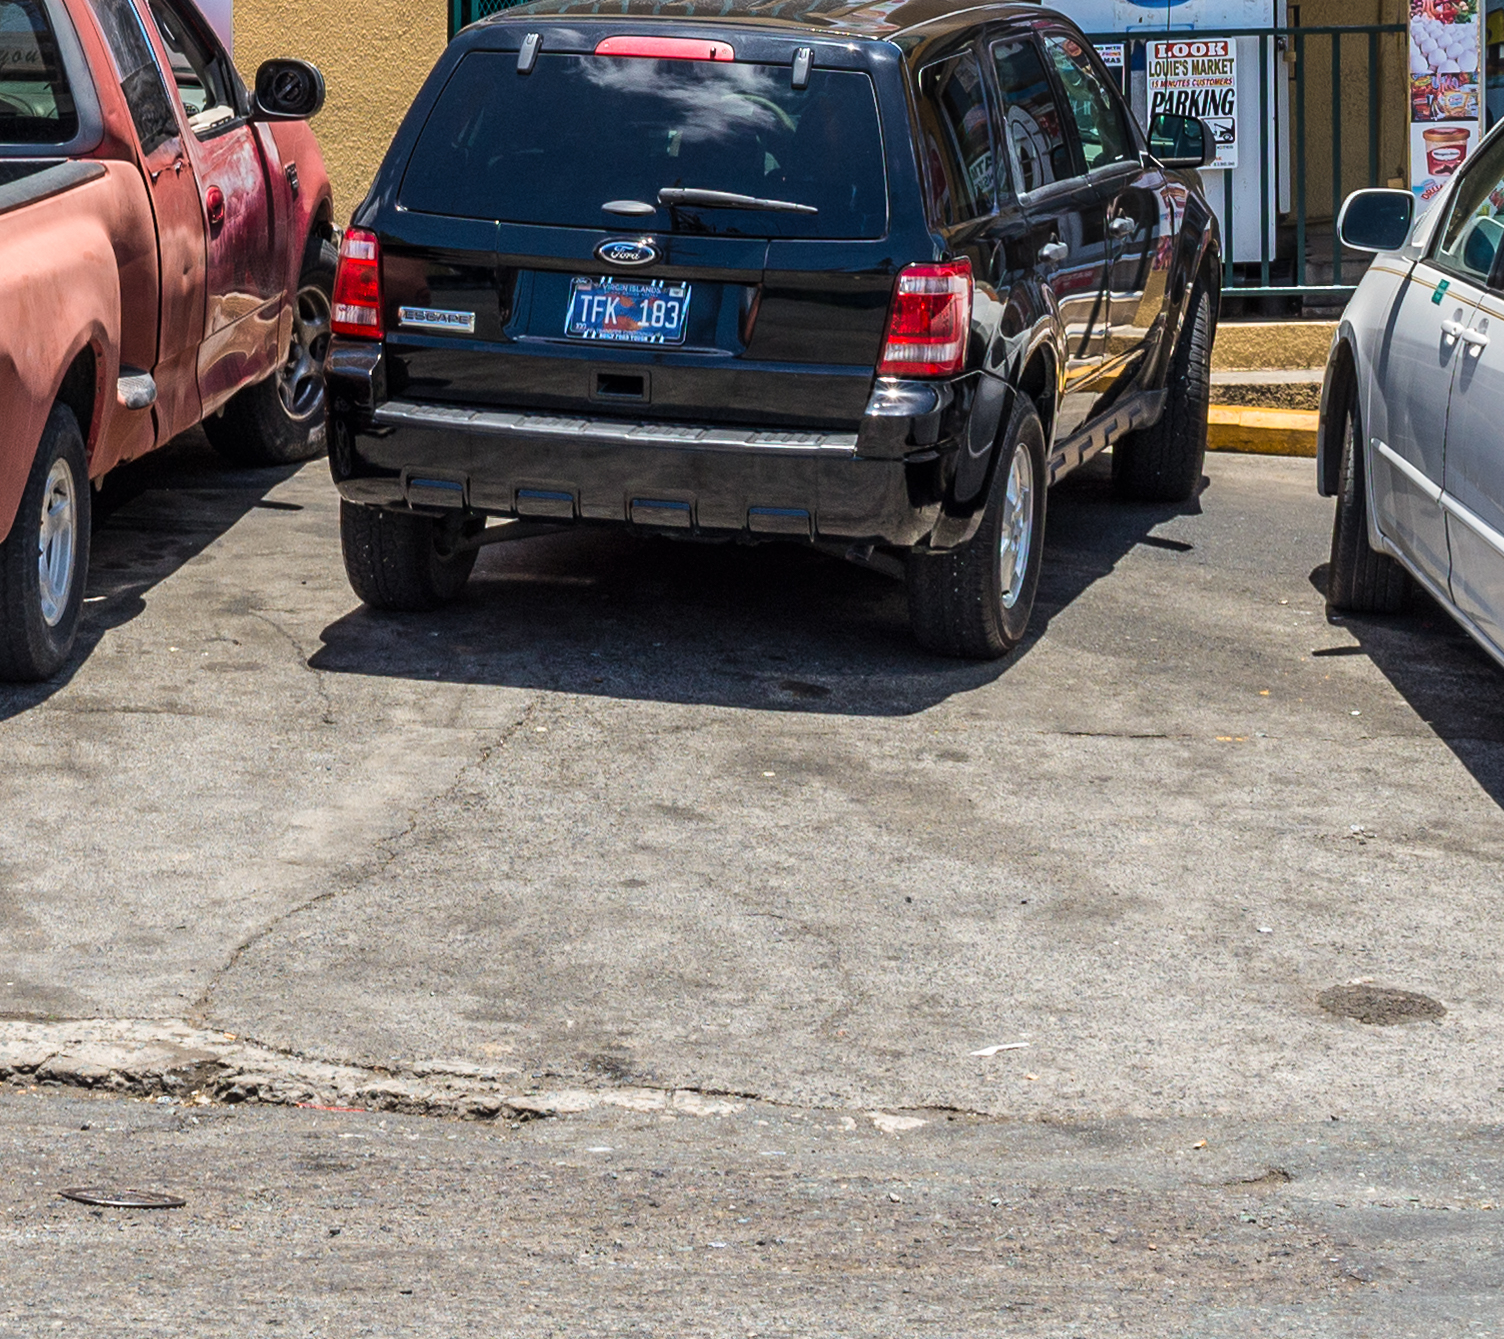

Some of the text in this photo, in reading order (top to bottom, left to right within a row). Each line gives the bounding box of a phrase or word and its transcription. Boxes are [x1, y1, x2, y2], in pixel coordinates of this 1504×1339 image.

[1157, 42, 1226, 57] LOOK
[1149, 58, 1234, 77] LOUIE'S MARKET
[1151, 88, 1235, 117] PARKING
[610, 243, 641, 260] Ford
[404, 310, 469, 325] ESCAPE
[580, 294, 679, 329] TFK 183
